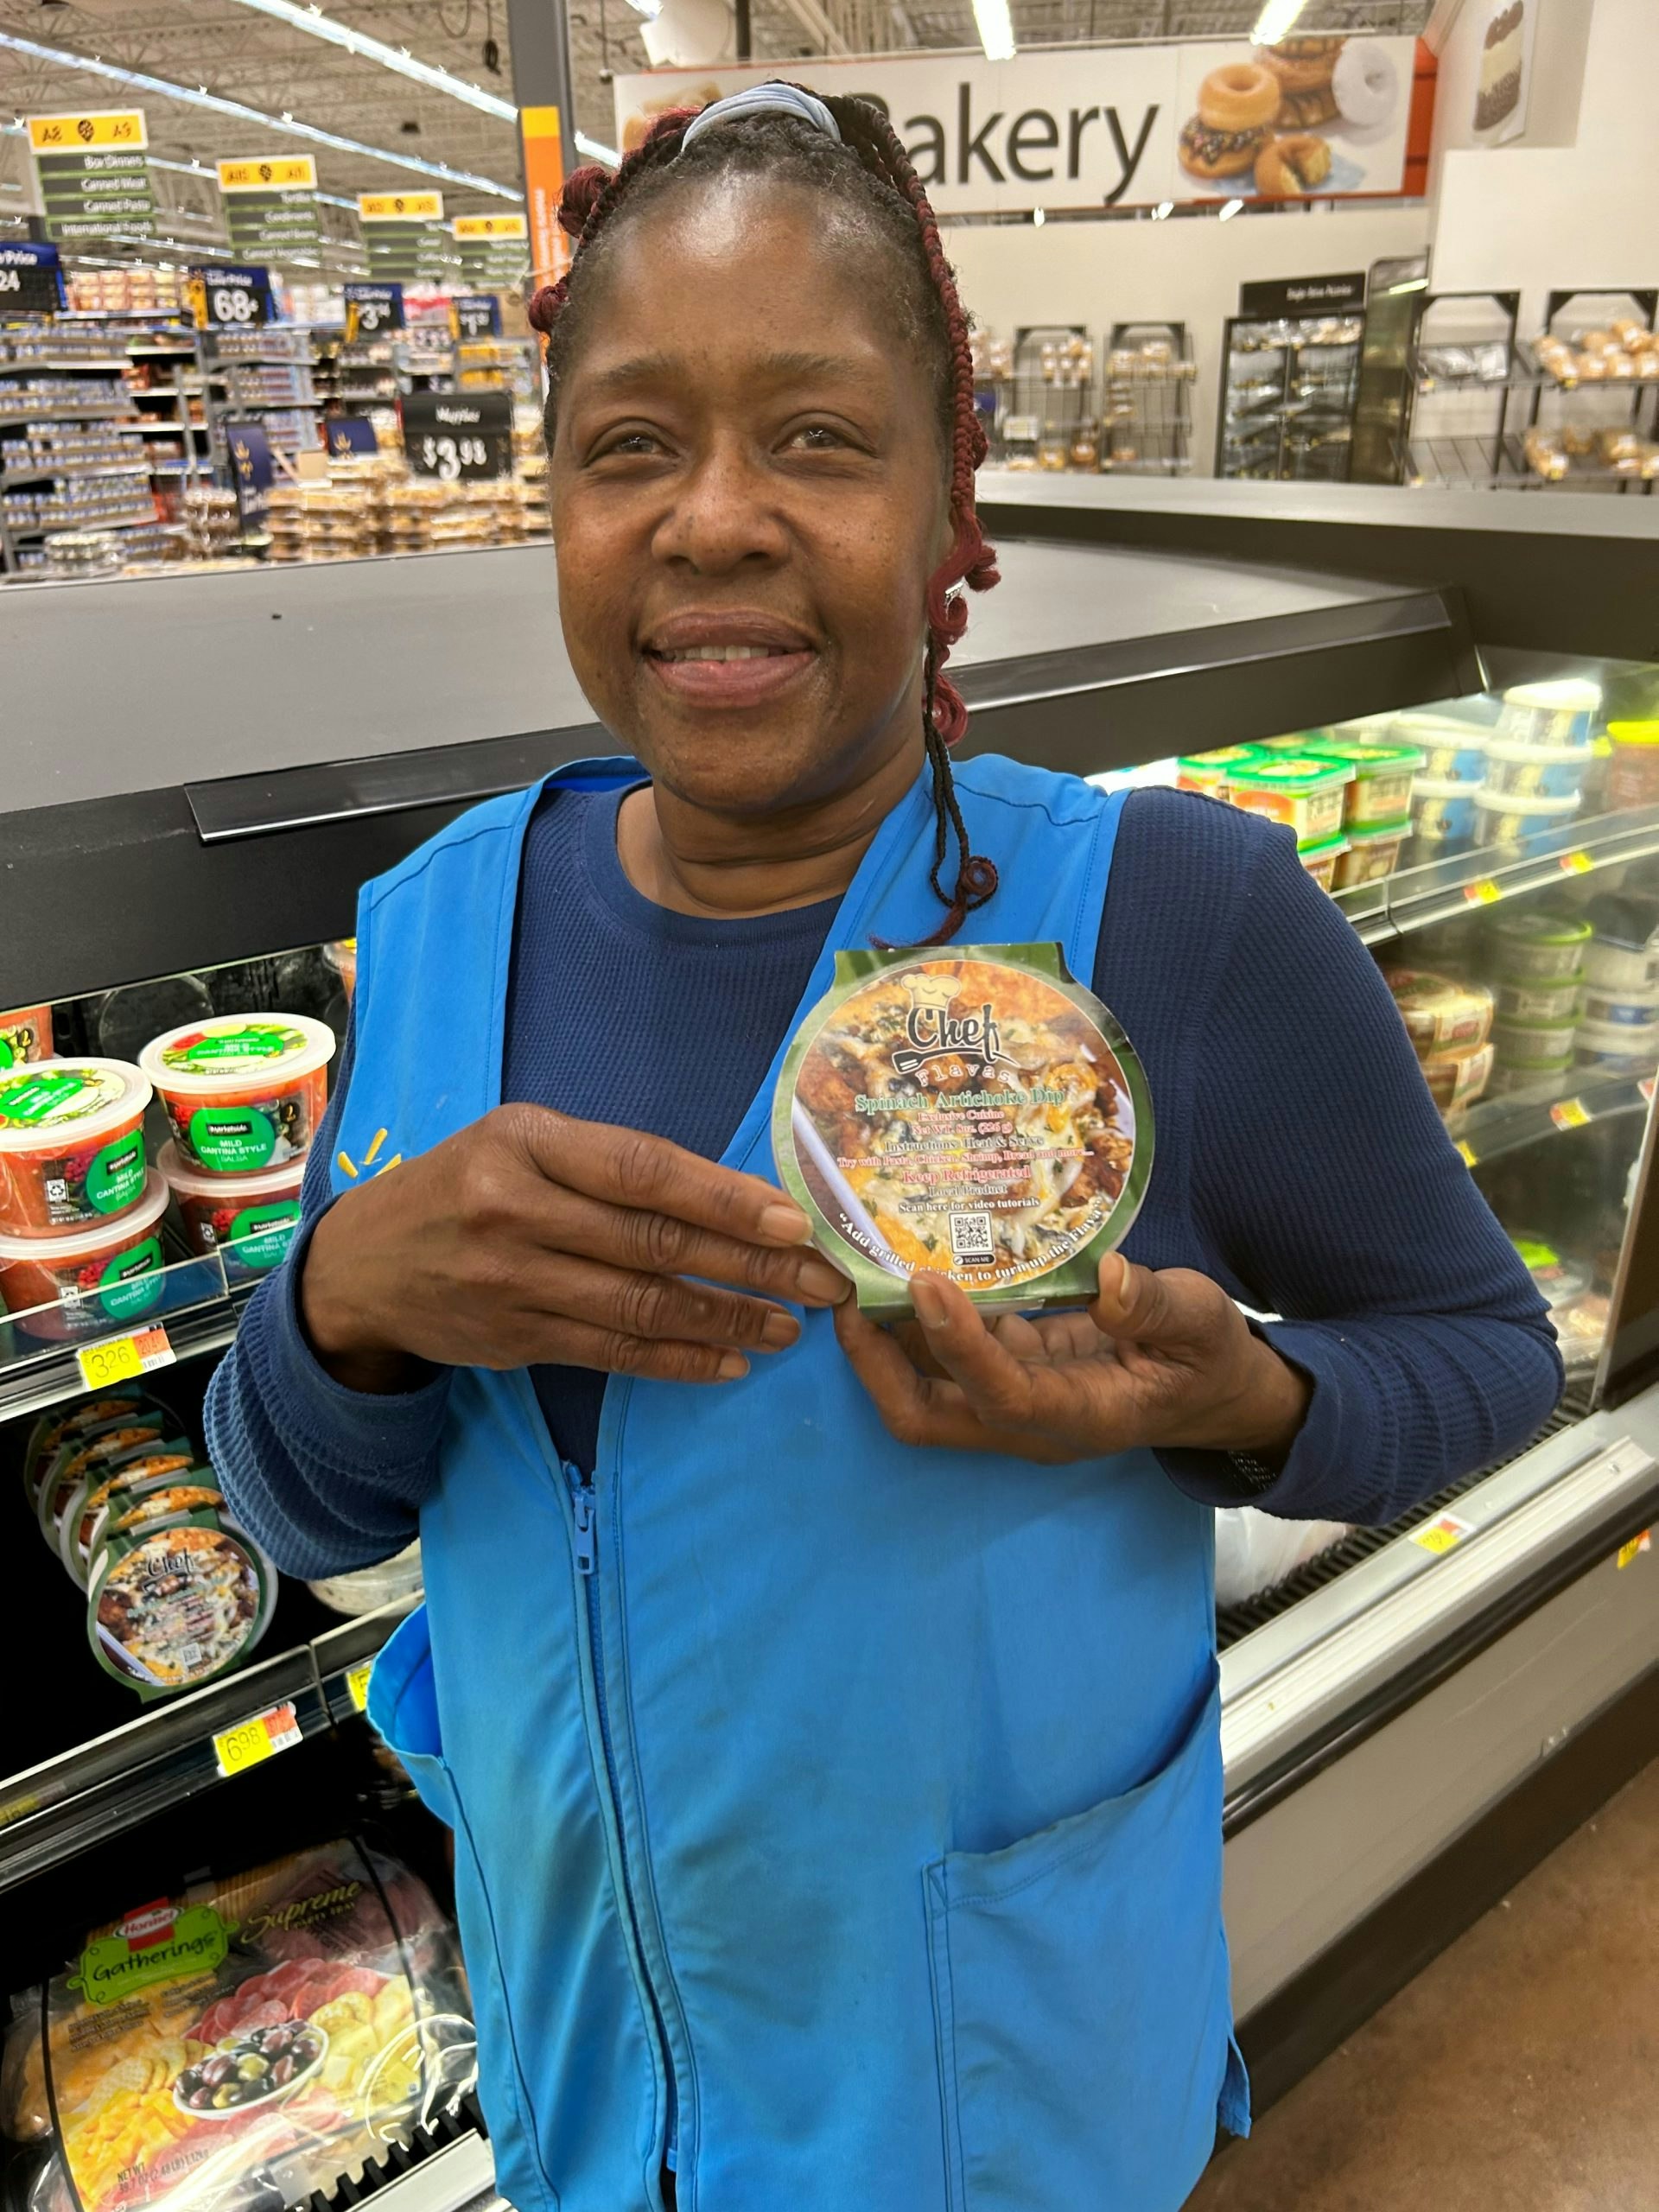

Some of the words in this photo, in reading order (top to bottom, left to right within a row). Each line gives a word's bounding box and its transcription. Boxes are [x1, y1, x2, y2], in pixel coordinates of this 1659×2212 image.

[908, 1004, 1000, 1062] Chef
[916, 1065, 1010, 1087] Flavas
[855, 1092, 929, 1116] Spinach
[935, 1089, 1027, 1109] Artichoke
[1030, 1088, 1065, 1106] Dip
[918, 1111, 966, 1122] Exclusive
[966, 1109, 1005, 1121] Cuisine
[200, 1146, 237, 1155] CANTINA
[238, 1143, 267, 1154] STYLE
[963, 1137, 994, 1148] Heat
[995, 1137, 1007, 1147] &
[1008, 1135, 1045, 1147] Serve
[837, 1157, 857, 1169] Try
[858, 1157, 881, 1166] with
[1002, 1149, 1035, 1161] Bread
[1036, 1150, 1056, 1159] and
[903, 1171, 939, 1185] Keep
[943, 1165, 1032, 1184] Refrigerated
[96, 1180, 130, 1199] CANTINA
[929, 1186, 962, 1197] Local
[962, 1185, 1007, 1195] Product
[899, 1202, 925, 1211] Scan
[926, 1201, 950, 1211] here
[950, 1200, 967, 1210] for
[969, 1198, 995, 1209] video
[997, 1197, 1040, 1208] tutorials
[868, 1244, 916, 1272] grilled
[977, 1271, 992, 1281] to
[995, 1262, 1027, 1279] turn
[1028, 1255, 1048, 1268] up
[1048, 1240, 1070, 1260] the
[92, 1346, 130, 1378] 326
[147, 1548, 195, 1578] Chef
[226, 1726, 261, 1762] 698
[124, 1910, 175, 1935] Hormel
[240, 1881, 360, 1944] Supreme
[92, 1930, 216, 1981] Gatherings
[118, 2167, 131, 2183] NET
[133, 2162, 145, 2176] WT
